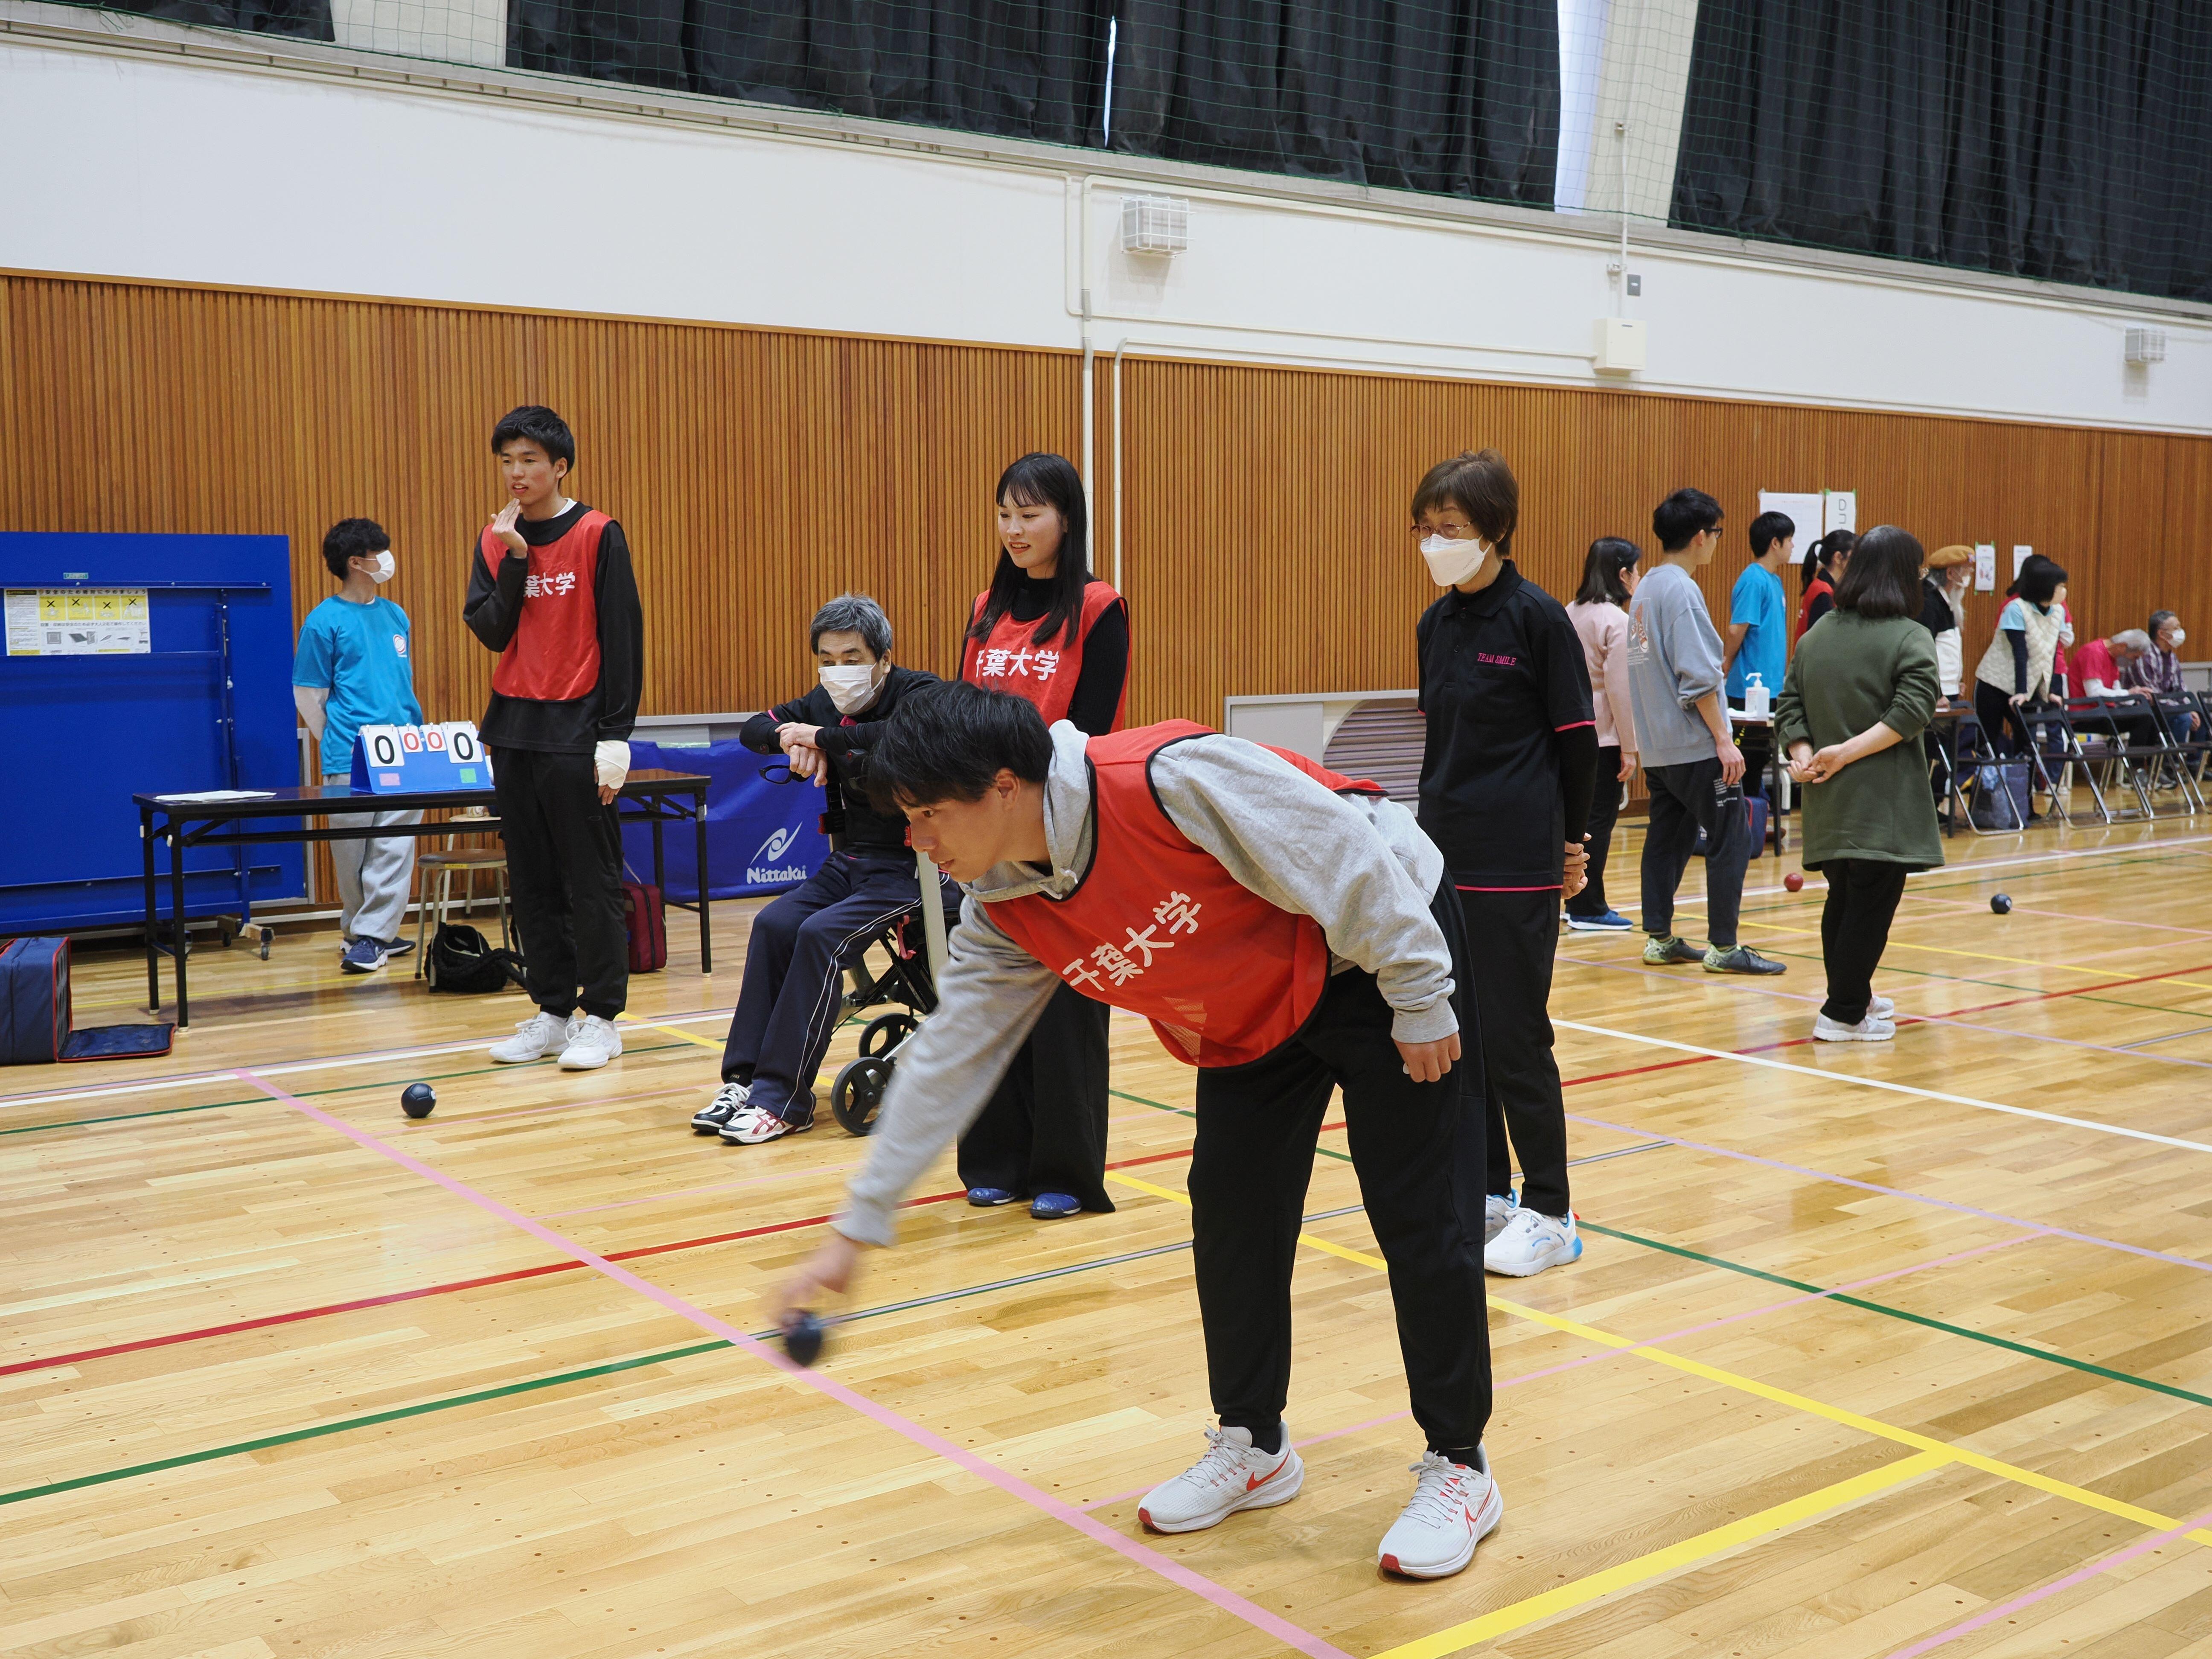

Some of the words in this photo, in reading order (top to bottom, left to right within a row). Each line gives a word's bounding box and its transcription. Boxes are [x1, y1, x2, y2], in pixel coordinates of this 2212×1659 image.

[523, 572, 575, 598] 葉大学
[1477, 652, 1495, 663] TEAM
[1495, 655, 1516, 666] SMILE
[375, 735, 395, 764] 0
[404, 733, 419, 750] 0
[427, 732, 442, 749] 0
[454, 732, 473, 760] 0
[747, 865, 807, 884] Nittaku
[1062, 891, 1202, 992] 千葉大学
